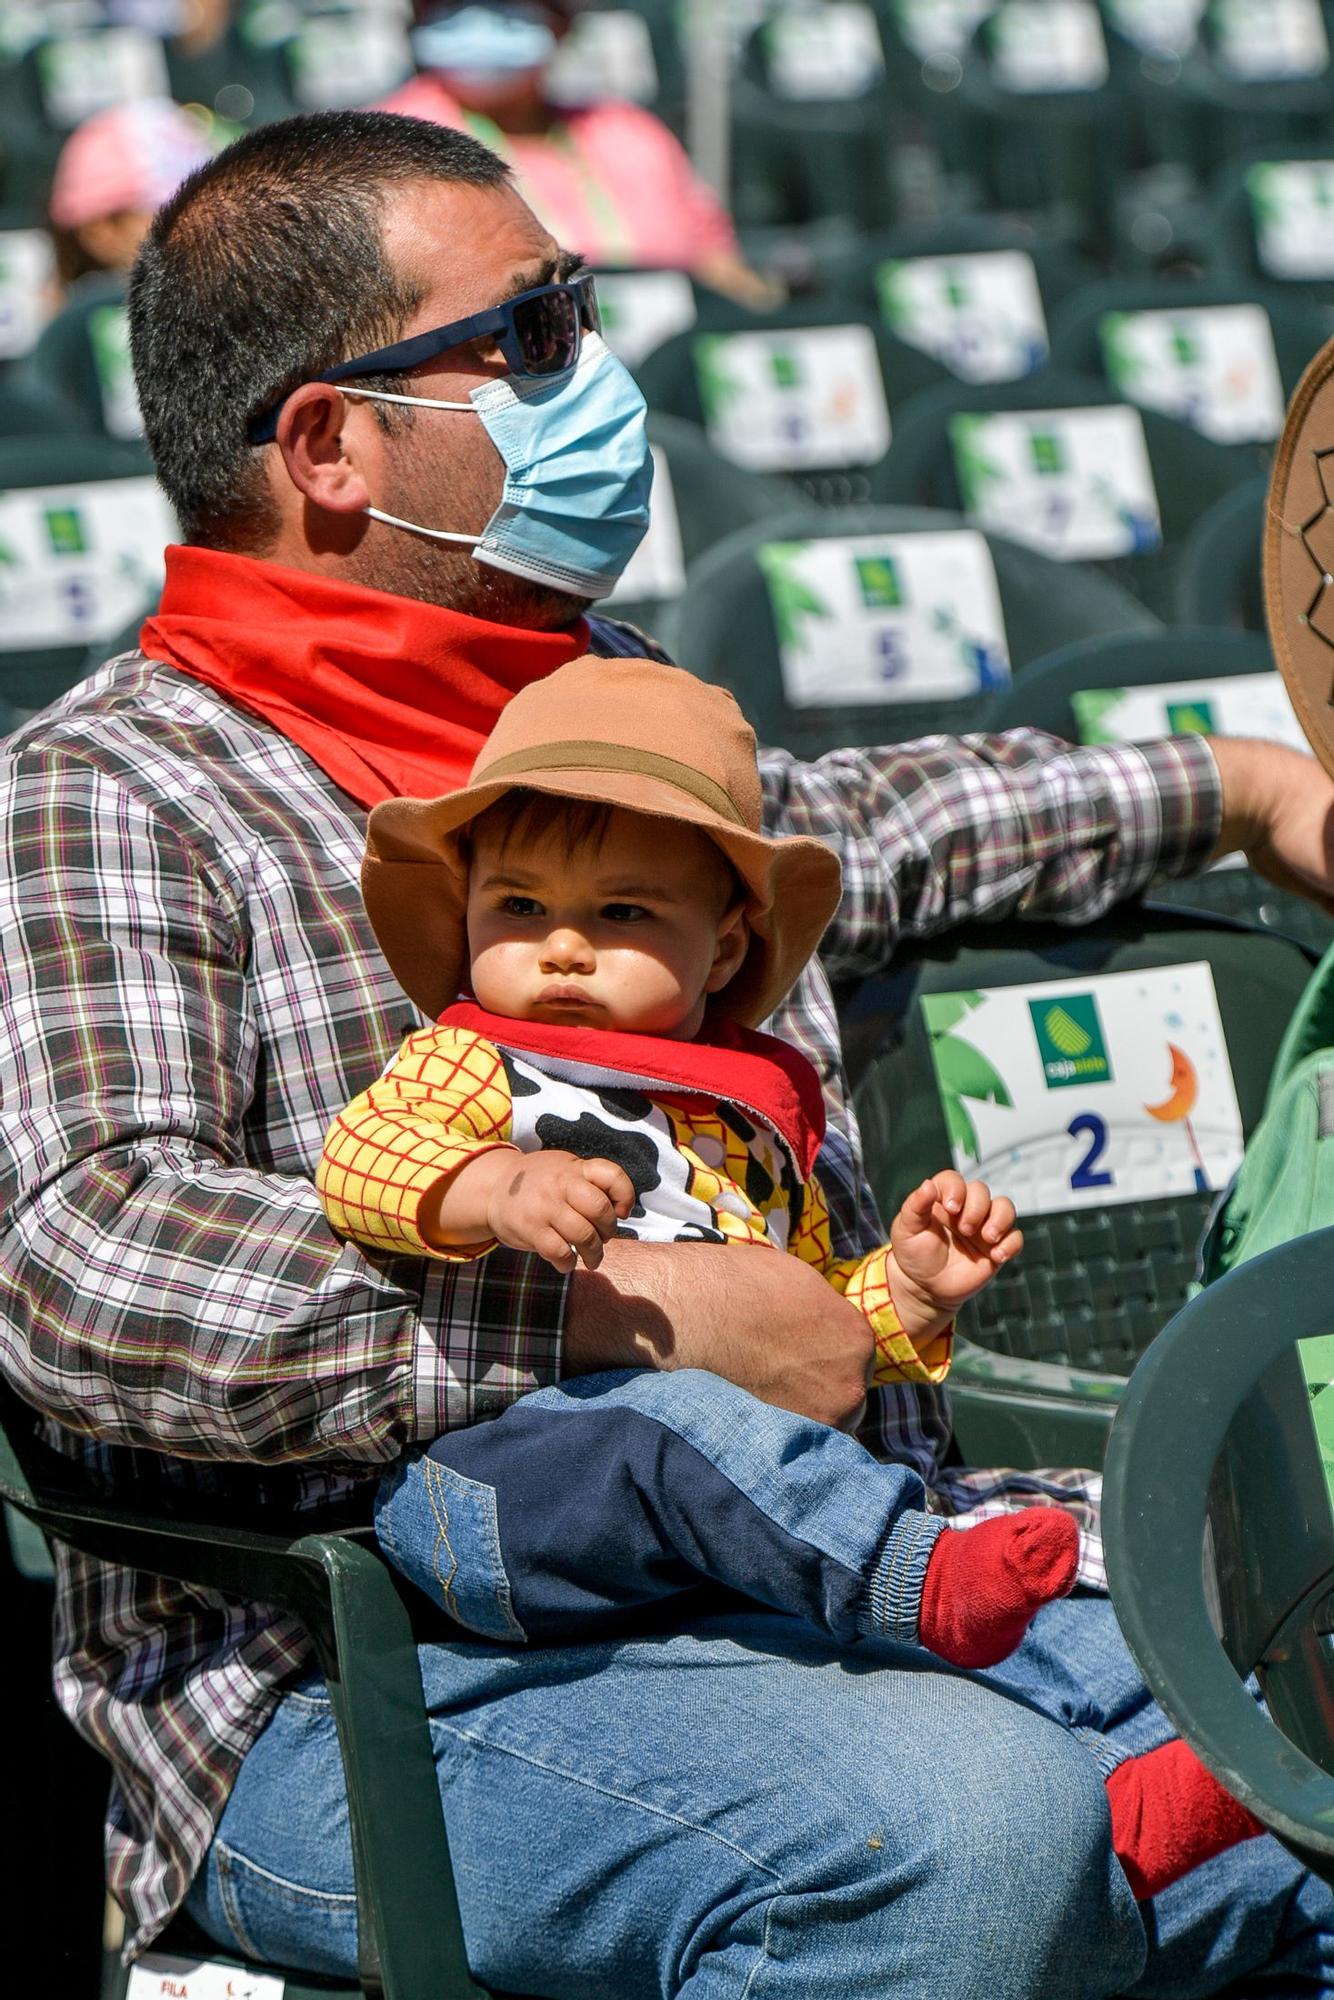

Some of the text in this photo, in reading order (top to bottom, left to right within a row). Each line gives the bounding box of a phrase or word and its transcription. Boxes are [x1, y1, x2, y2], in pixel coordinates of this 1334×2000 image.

[873, 627, 909, 683] 5
[1067, 1112, 1114, 1189] 2
[160, 1980, 188, 1998] FILA
